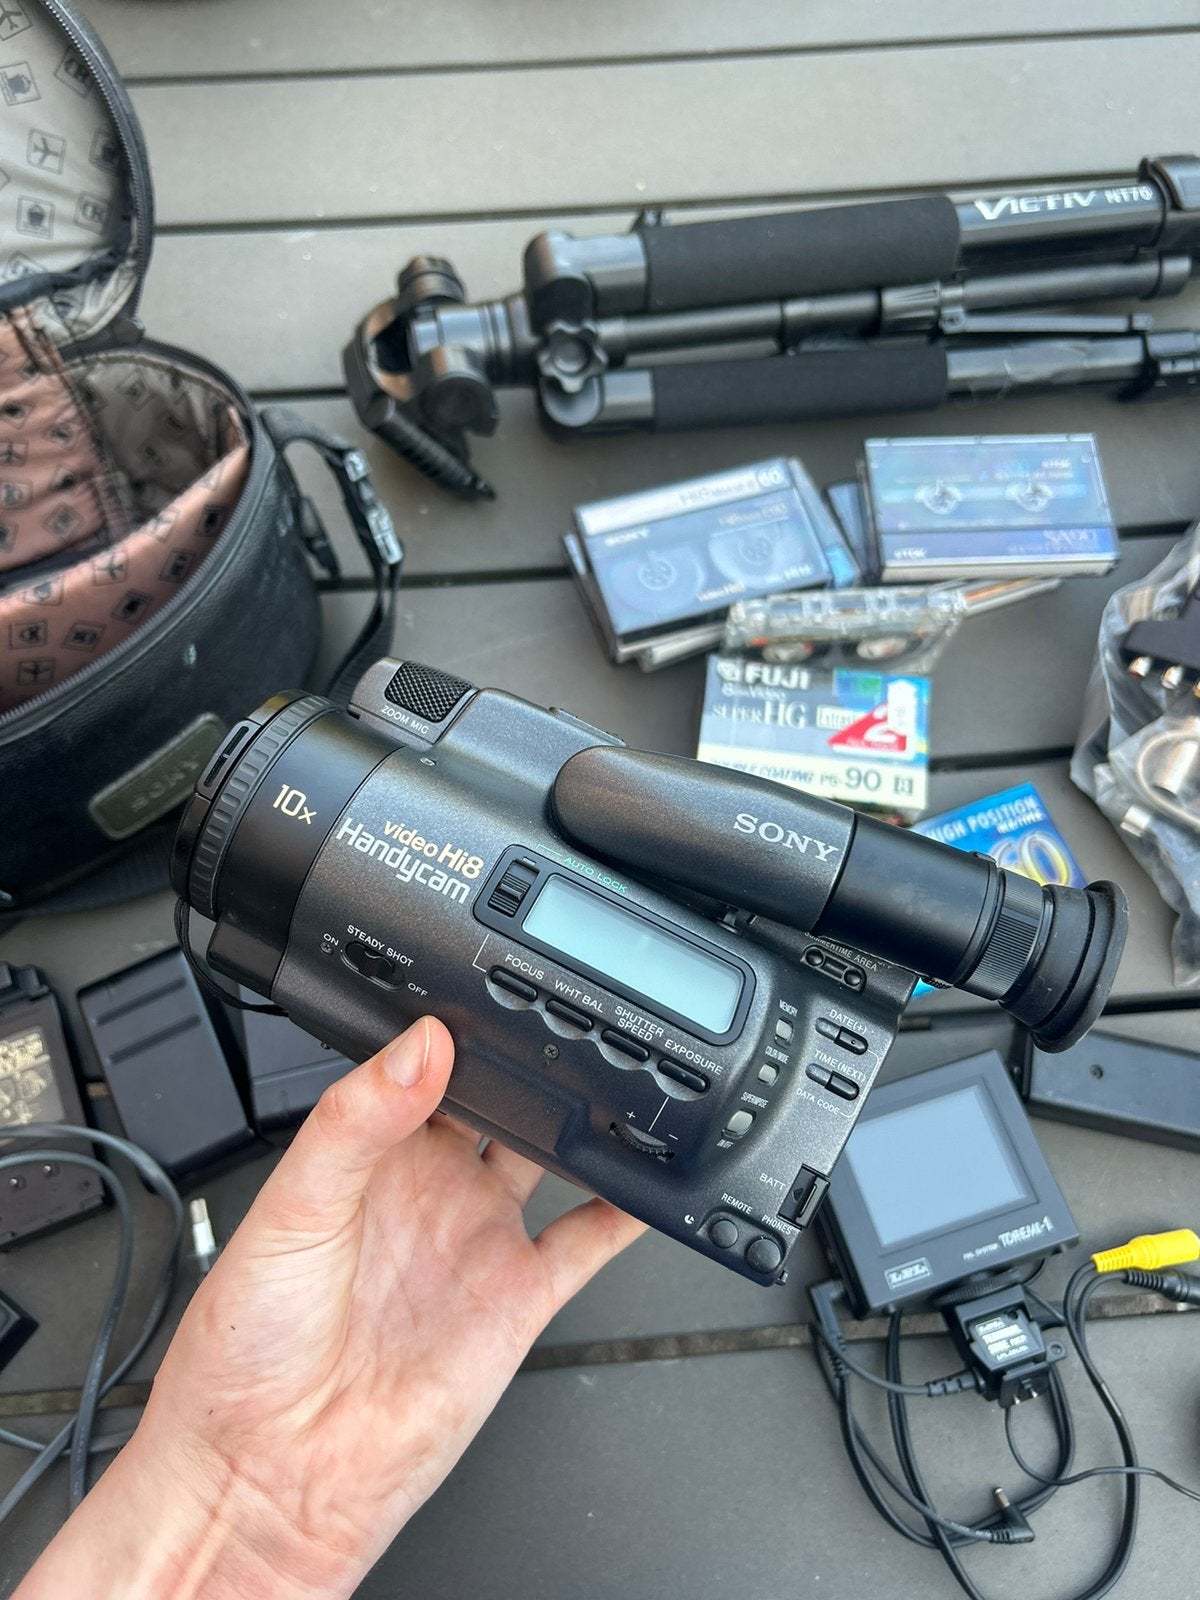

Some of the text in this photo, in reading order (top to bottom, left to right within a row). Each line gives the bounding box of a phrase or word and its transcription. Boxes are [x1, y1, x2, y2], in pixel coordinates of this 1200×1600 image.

[974, 190, 1096, 221] VICTIV
[745, 661, 809, 690] FUJI
[381, 705, 430, 735] ZOOM MIC
[272, 783, 318, 825] 10x
[966, 795, 1039, 833] POSITION
[733, 812, 839, 862] SONY
[335, 817, 471, 905] Handycam
[563, 857, 627, 893] AUTO LOCK
[323, 933, 339, 946] ON
[347, 924, 415, 967] STEADY SHOT
[504, 953, 545, 981] FOCUS
[853, 949, 878, 972] AREA
[407, 982, 429, 997] OFF
[554, 979, 604, 1014] WHT BAL
[614, 1005, 665, 1038] SHUTTER
[617, 1017, 654, 1042] SPEED
[664, 1038, 724, 1076] EXPOSURE
[795, 1087, 841, 1116] DATA CODE
[759, 1172, 787, 1191] BATT
[721, 1192, 753, 1215] REMOTE
[761, 1214, 793, 1235] PHONES
